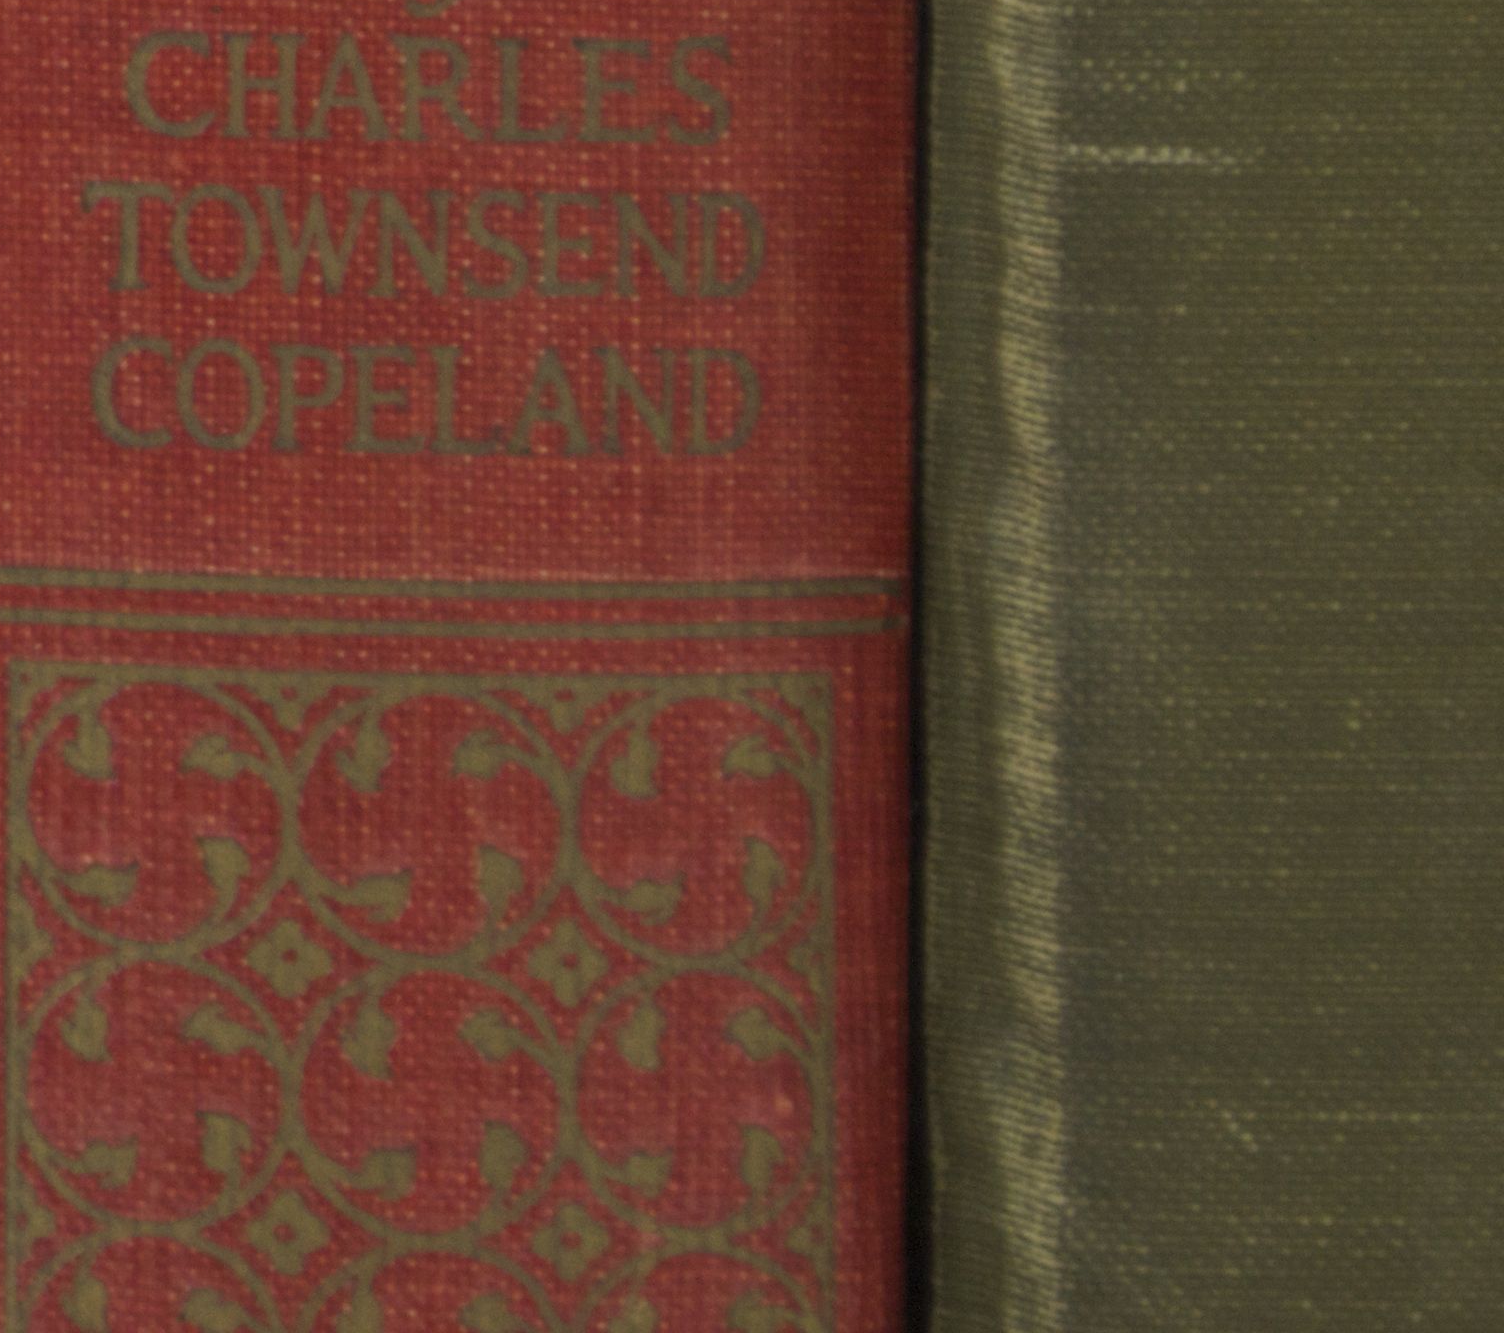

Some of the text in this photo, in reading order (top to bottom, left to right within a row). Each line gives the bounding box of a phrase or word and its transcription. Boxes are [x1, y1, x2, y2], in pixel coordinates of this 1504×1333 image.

[124, 30, 735, 144] CHARLES
[81, 179, 767, 300] TOWNSEND
[90, 333, 763, 457] COPELAND
